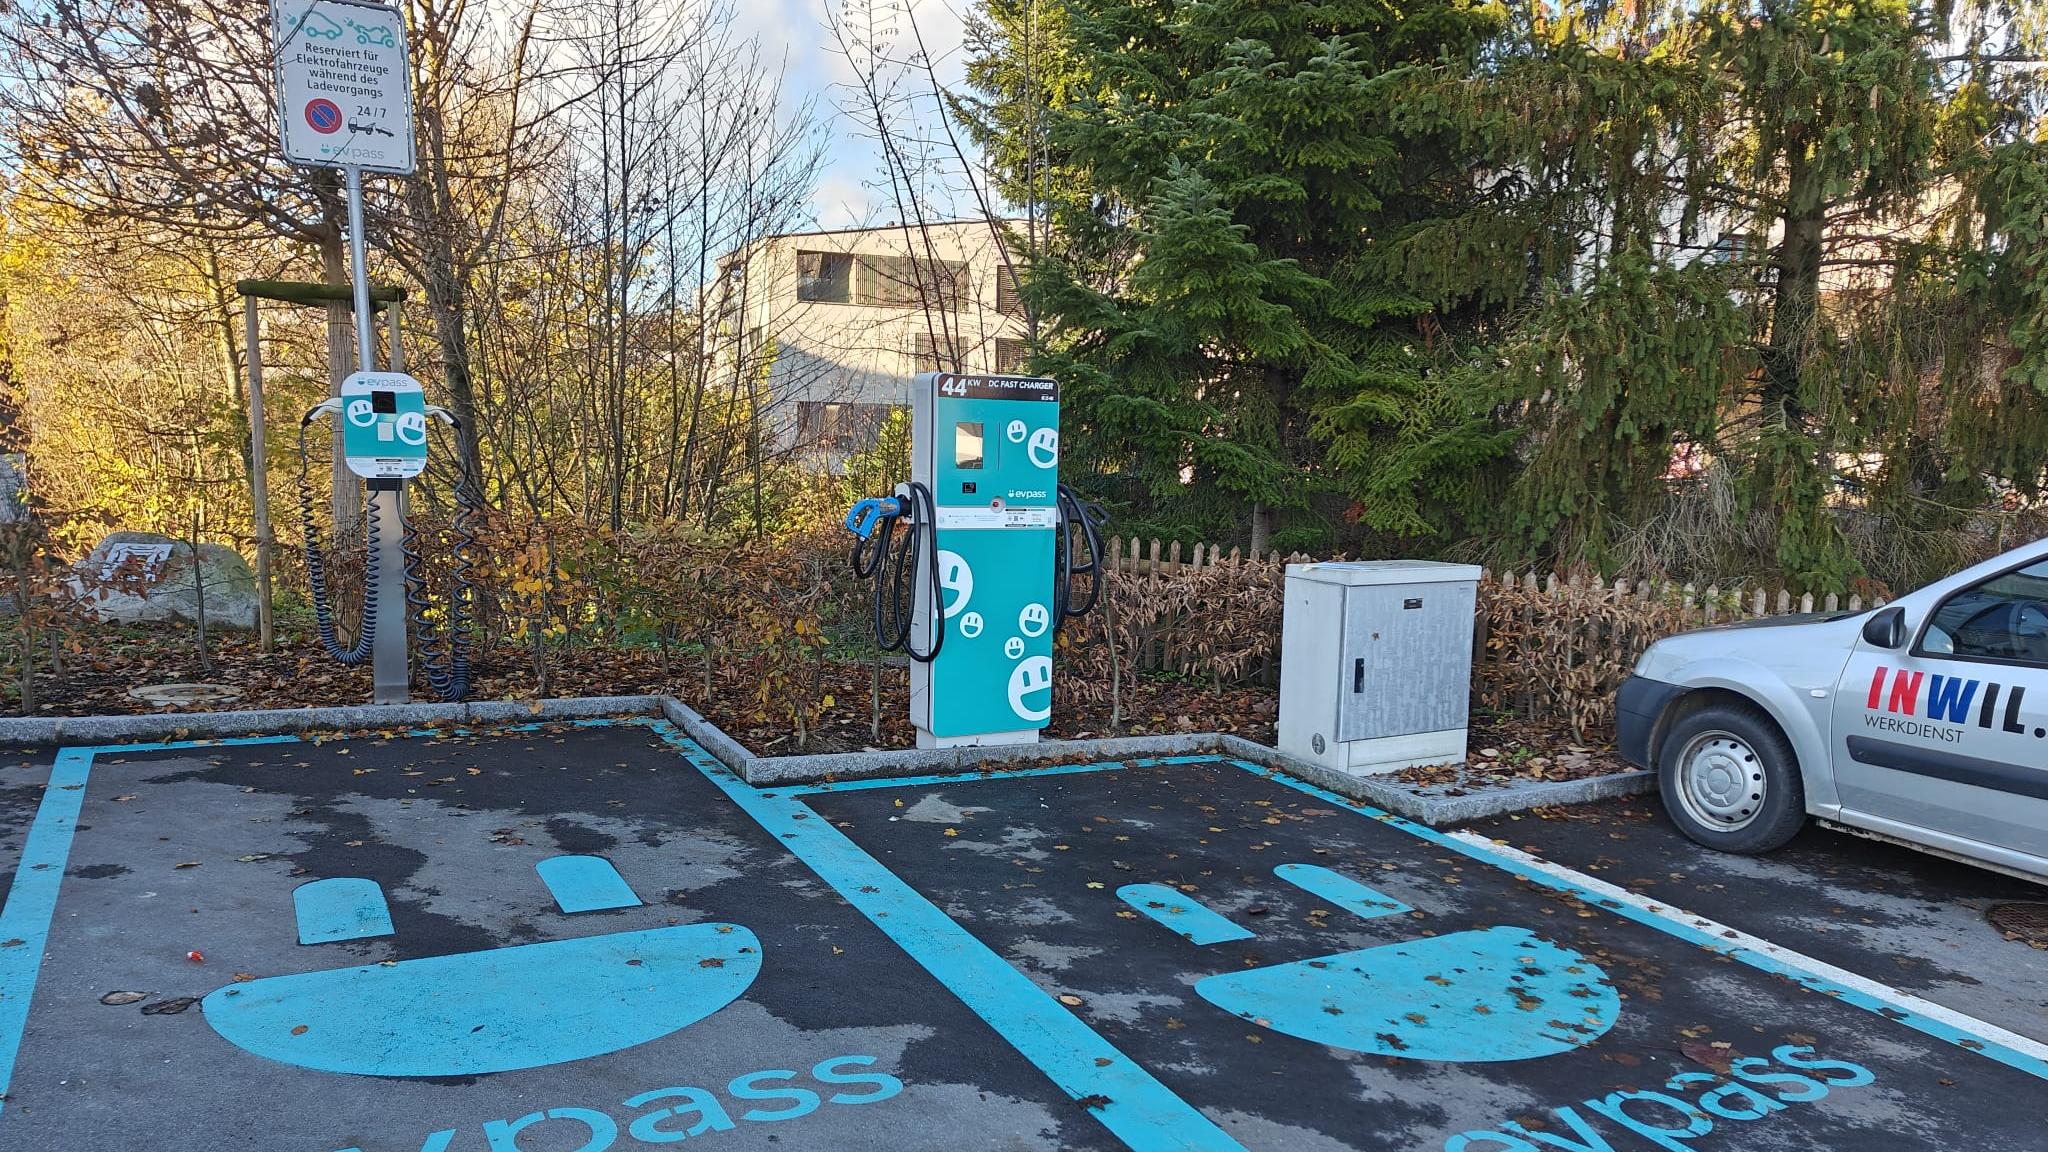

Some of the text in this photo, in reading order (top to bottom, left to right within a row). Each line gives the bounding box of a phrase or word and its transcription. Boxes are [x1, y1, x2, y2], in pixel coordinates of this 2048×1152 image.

[305, 42, 379, 61] Reserviert für
[296, 53, 389, 76] Elektrofahrzeuge
[309, 69, 379, 85] während des
[307, 79, 384, 99] Ladevorgangs
[333, 145, 385, 160] evpass
[367, 379, 408, 387] evpass
[941, 377, 967, 396] 44
[1000, 380, 1018, 388] FAST
[1019, 381, 1054, 390] CHARGER
[1015, 490, 1047, 499] evpass
[1864, 714, 1965, 744] WERKDIENST
